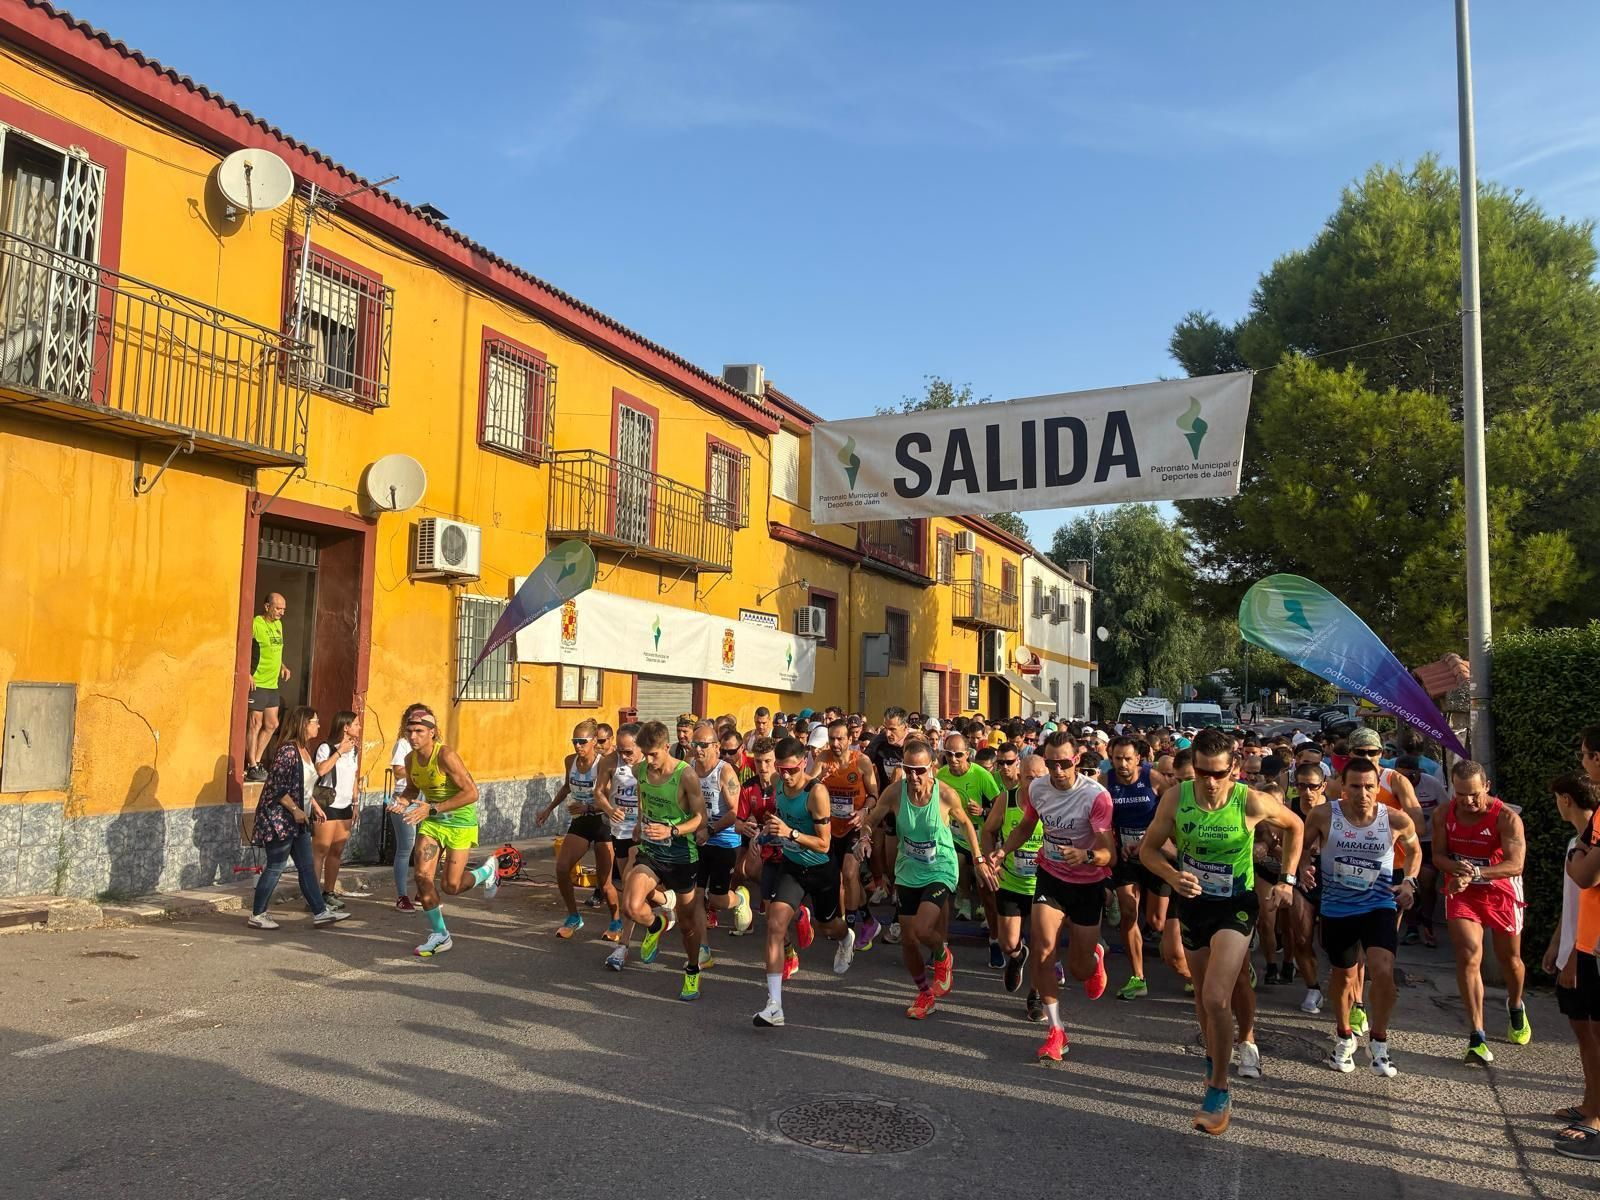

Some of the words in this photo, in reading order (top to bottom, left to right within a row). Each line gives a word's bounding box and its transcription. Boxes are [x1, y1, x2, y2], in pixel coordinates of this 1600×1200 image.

[893, 409, 1142, 499] SALIDA
[1150, 464, 1190, 473] Patronato
[1191, 461, 1231, 470] Municipal
[1161, 472, 1198, 482] Deportes
[1200, 471, 1211, 479] de
[1212, 470, 1233, 478] Jaén
[818, 494, 848, 502] Patronato
[848, 491, 879, 500] Municipal
[880, 490, 888, 498] de
[827, 500, 854, 509] Deportes
[1322, 666, 1444, 739] patronatodeportesjaen.es
[1044, 814, 1075, 830] Salud
[1198, 824, 1239, 833] Fundación
[1198, 832, 1229, 840] Unicaja
[1336, 840, 1385, 851] MARACENA
[1202, 872, 1210, 880] 6
[1352, 866, 1364, 876] 19
